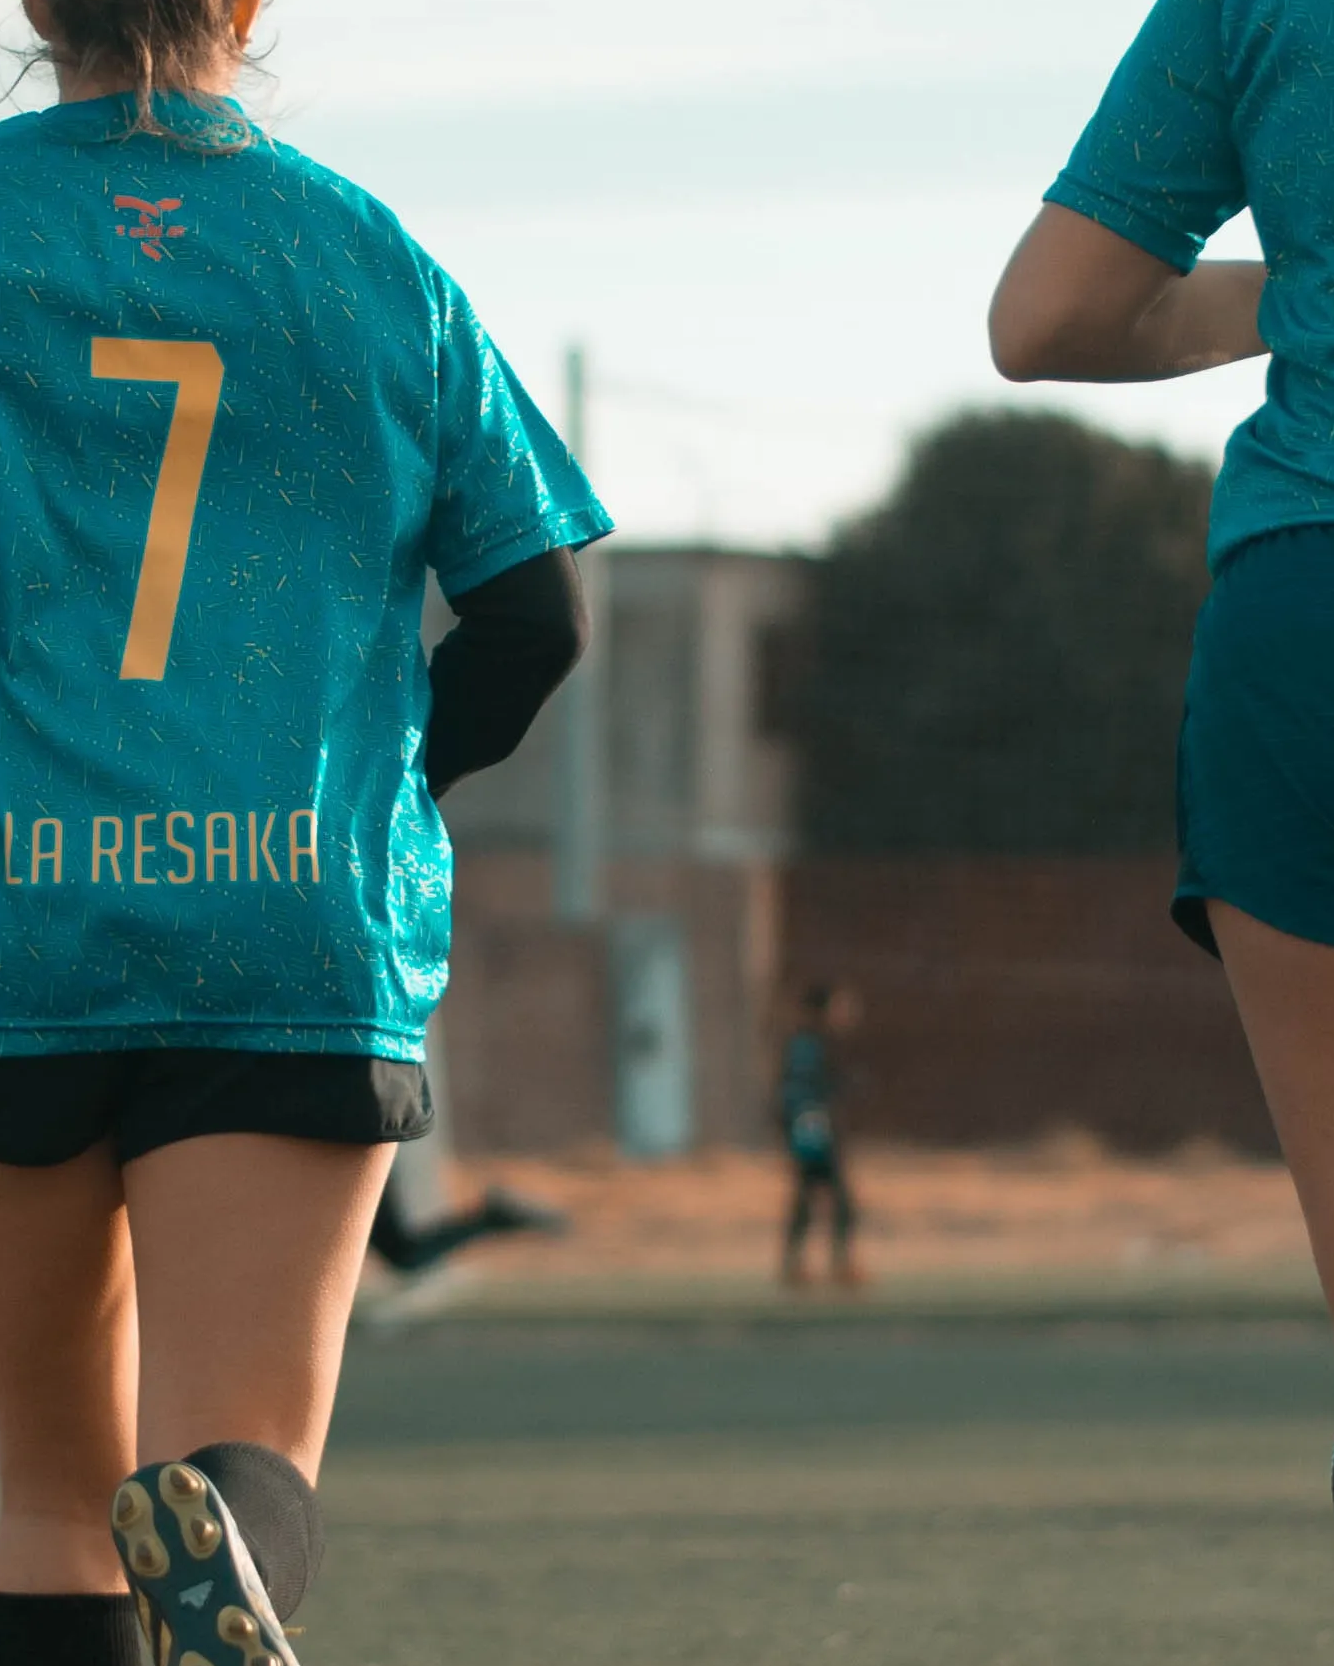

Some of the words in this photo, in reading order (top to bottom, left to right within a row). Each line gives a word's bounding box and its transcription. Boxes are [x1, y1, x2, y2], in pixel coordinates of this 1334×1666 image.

[91, 337, 225, 680] 7
[4, 811, 63, 884] LA
[91, 809, 320, 883] RESAKA
